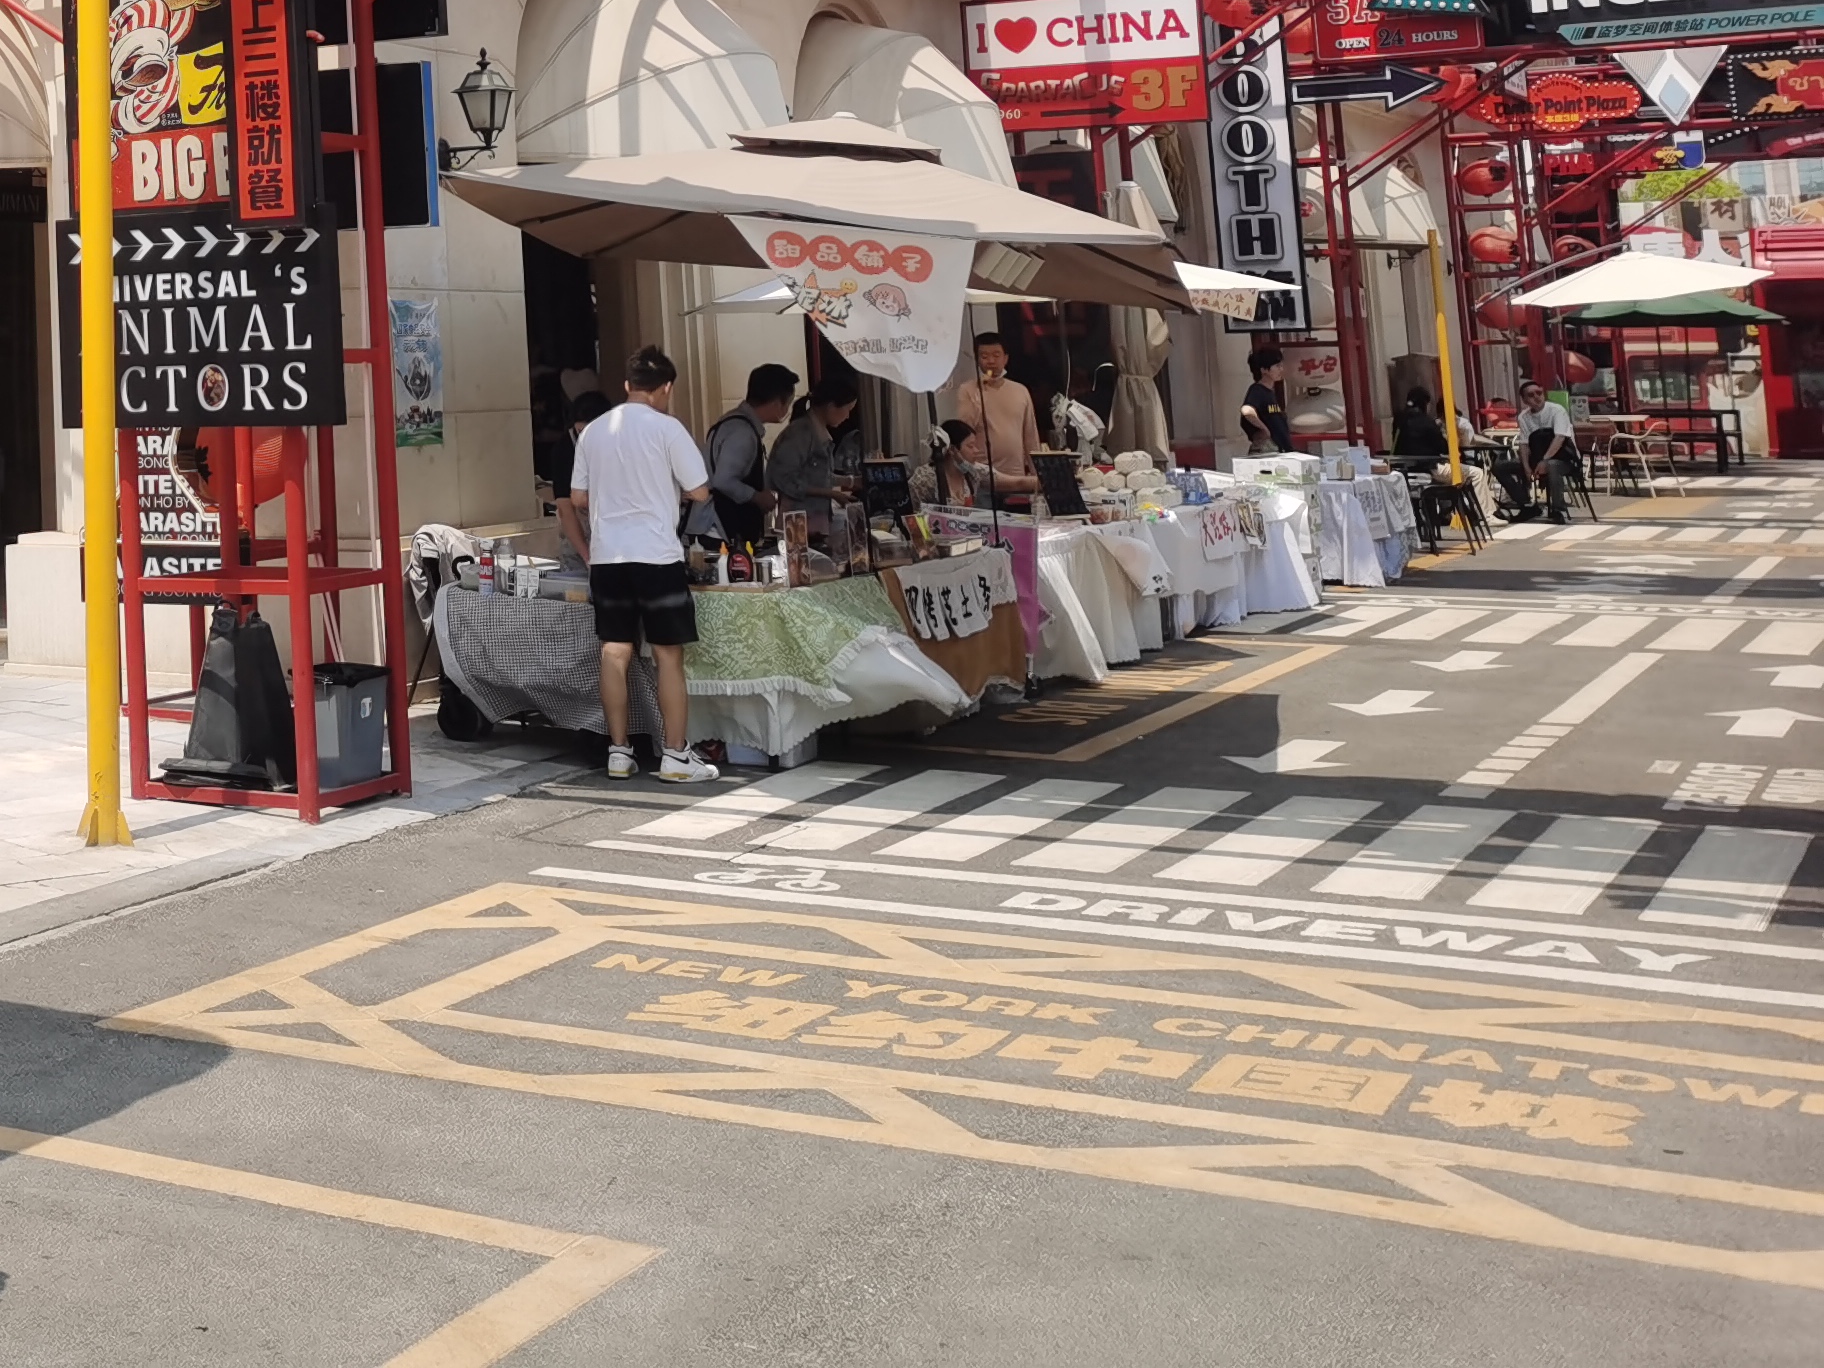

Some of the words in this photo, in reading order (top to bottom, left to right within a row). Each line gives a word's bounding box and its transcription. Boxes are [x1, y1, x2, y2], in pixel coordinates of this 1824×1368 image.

[976, 22, 988, 54] I
[1046, 8, 1190, 48] CHINA
[1335, 36, 1371, 51] OPEN
[1379, 27, 1404, 50] 24
[1412, 28, 1458, 44] HOURS
[1596, 18, 1703, 39] 盗梦空间体验站
[1707, 12, 1764, 29] POWER
[1768, 7, 1815, 25] POLE
[1130, 65, 1198, 112] 3F
[1585, 94, 1628, 111] Plaza
[132, 134, 207, 202] BIG
[999, 891, 1713, 972] DRIVEWAY
[591, 952, 808, 988] NEW
[843, 978, 1116, 1026] YORK
[1152, 1017, 1824, 1115] CHINATOW
[626, 988, 1644, 1148] 纽约中国城
